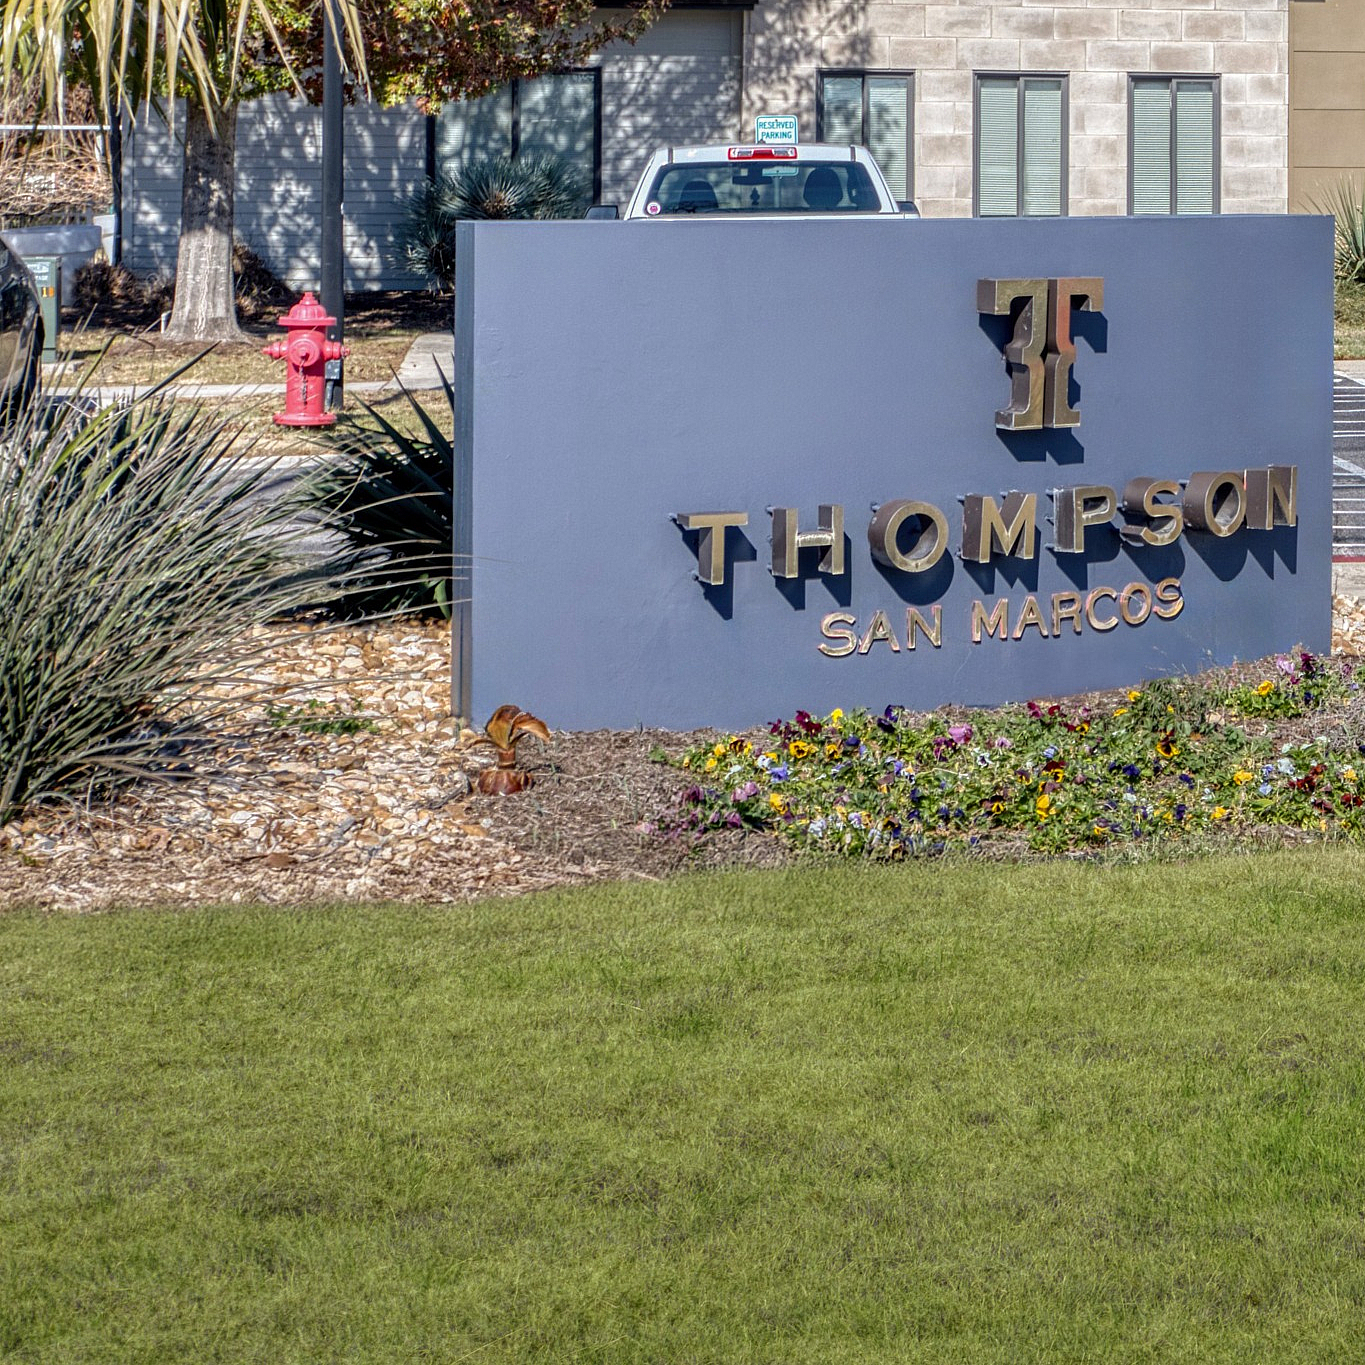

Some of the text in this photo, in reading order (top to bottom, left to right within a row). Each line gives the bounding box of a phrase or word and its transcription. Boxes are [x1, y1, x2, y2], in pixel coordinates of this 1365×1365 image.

[758, 121, 795, 129] RESERVED
[761, 131, 792, 139] PARKING
[676, 464, 1299, 586] THOMPSON
[816, 577, 1186, 658] SAN MARCOS
